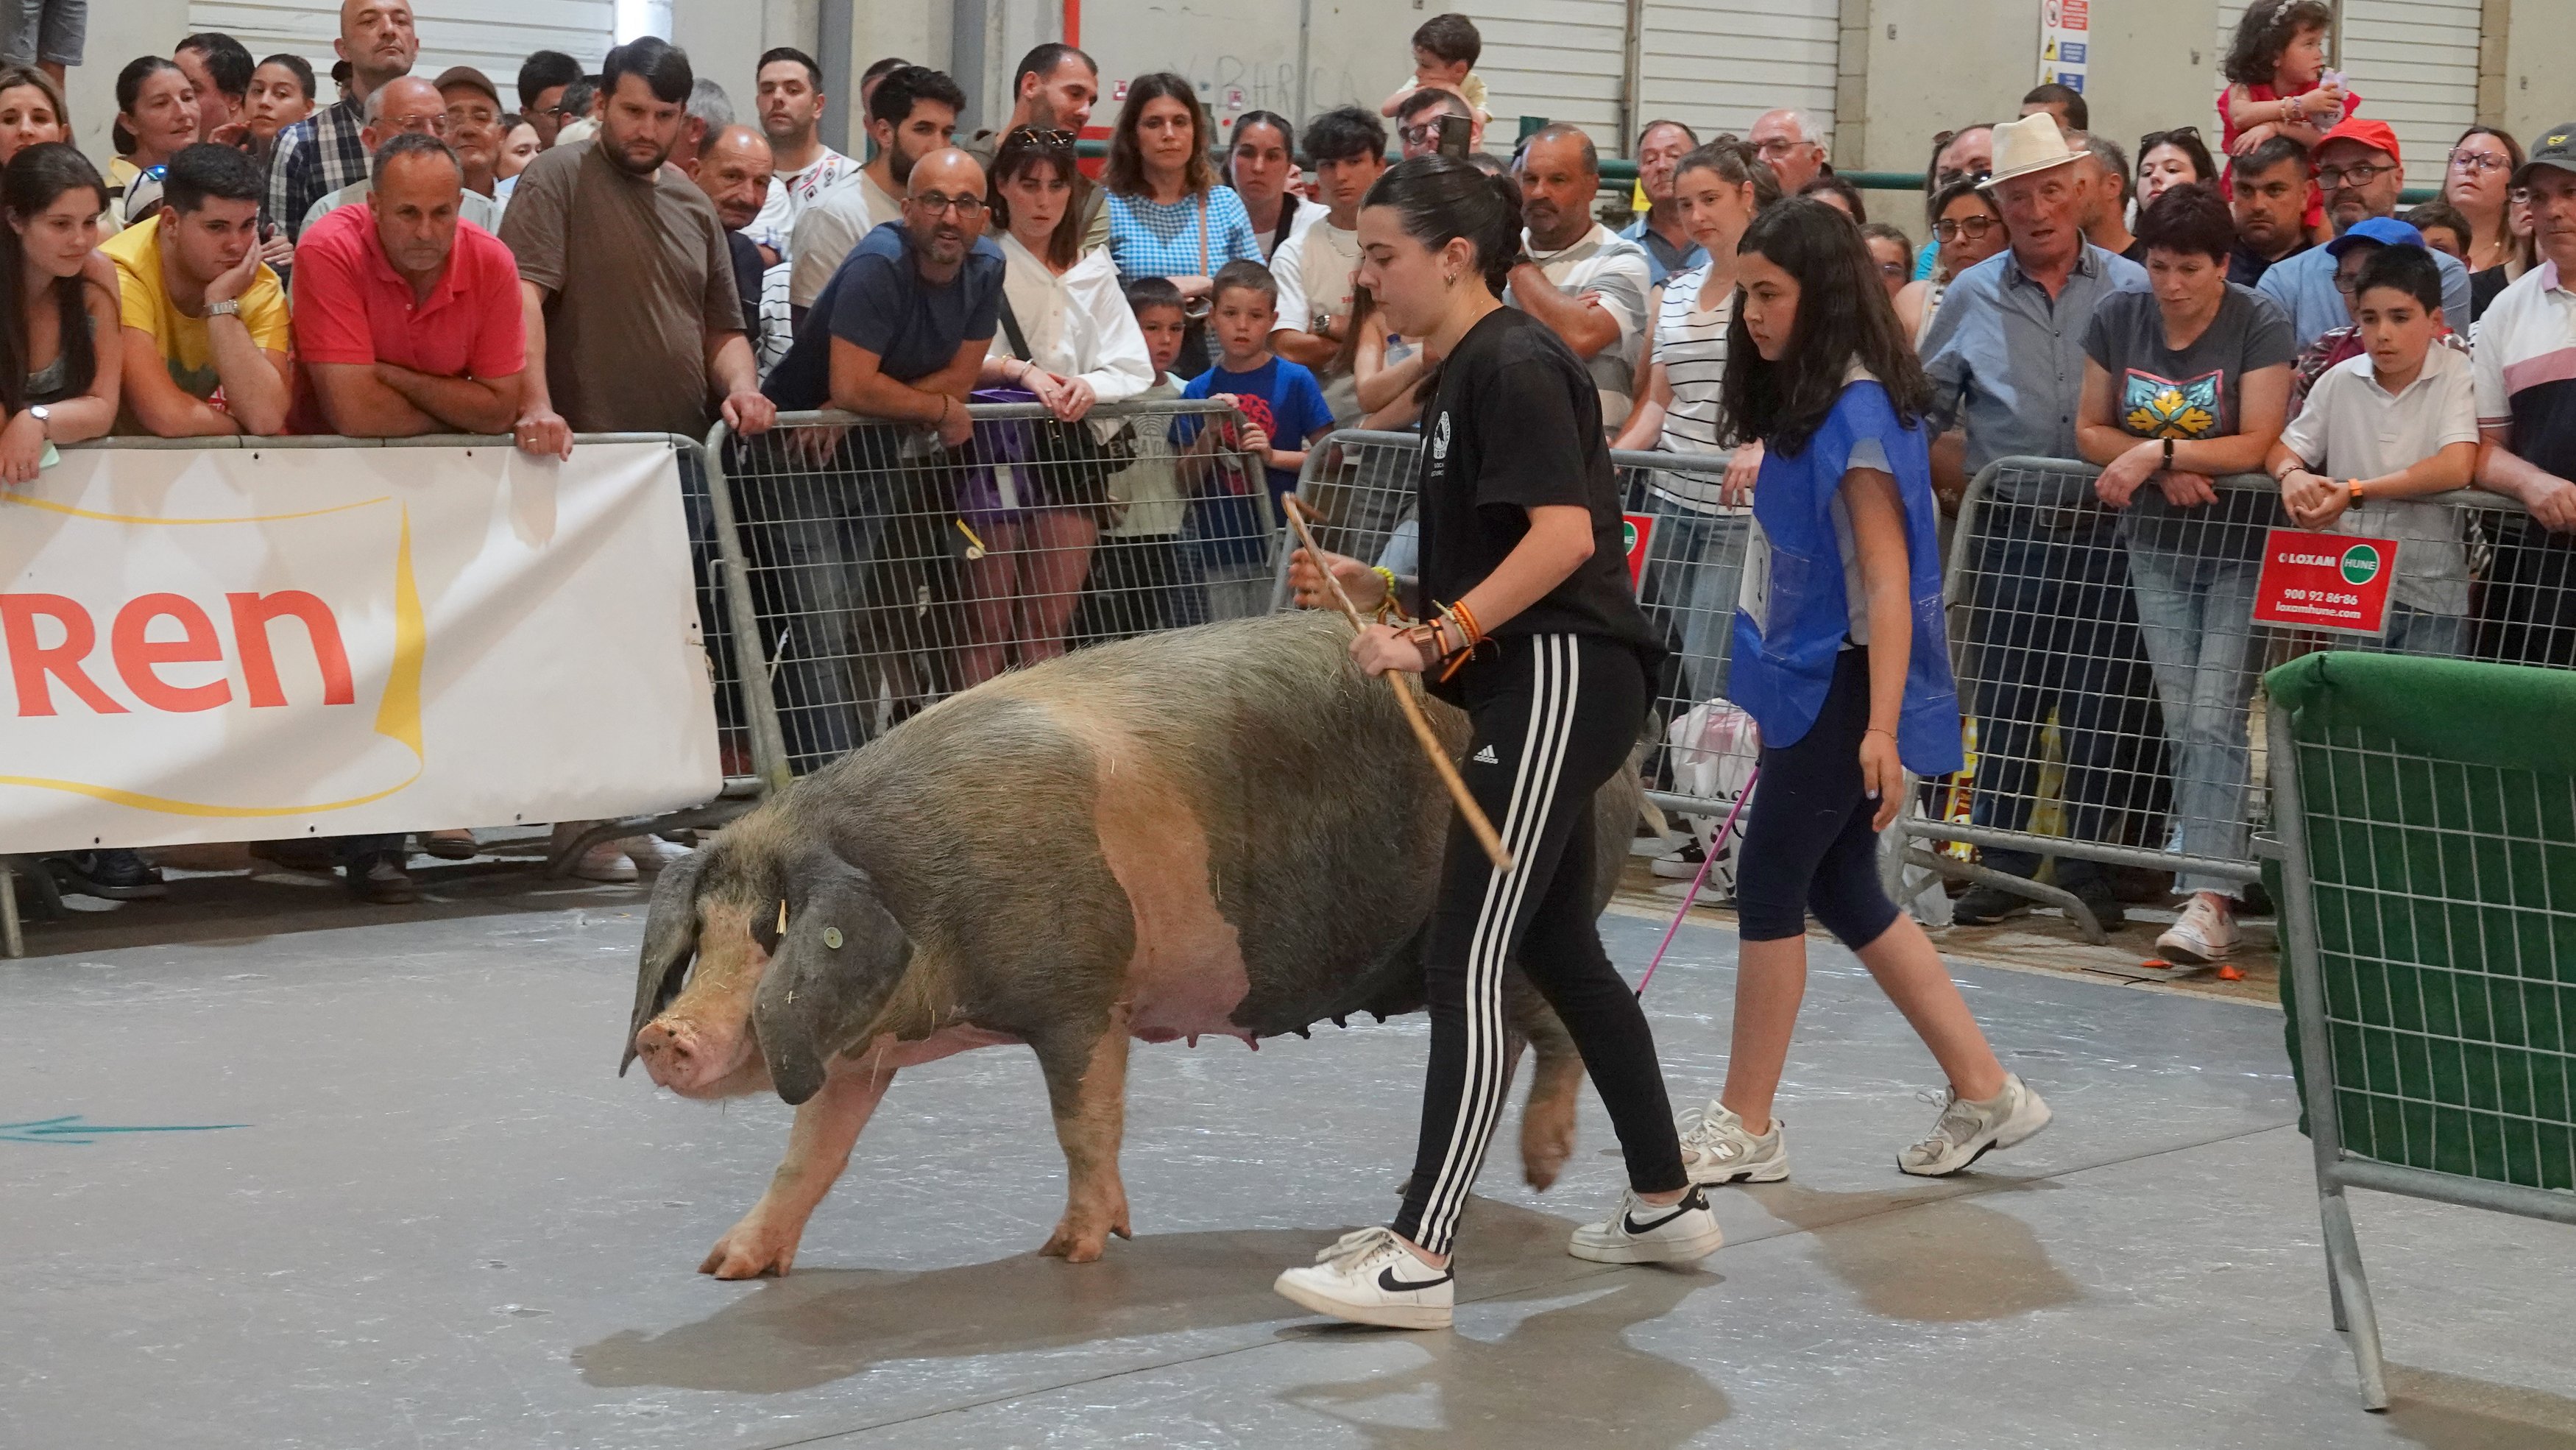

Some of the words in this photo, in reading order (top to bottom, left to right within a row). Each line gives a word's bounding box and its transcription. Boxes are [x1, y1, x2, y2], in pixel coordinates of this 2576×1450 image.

[2288, 554, 2336, 567] LOXAM
[2344, 559, 2377, 570] HUNE
[2284, 589, 2306, 600] 900
[2308, 591, 2324, 602] 92
[2275, 601, 2361, 619] loxamhune.com
